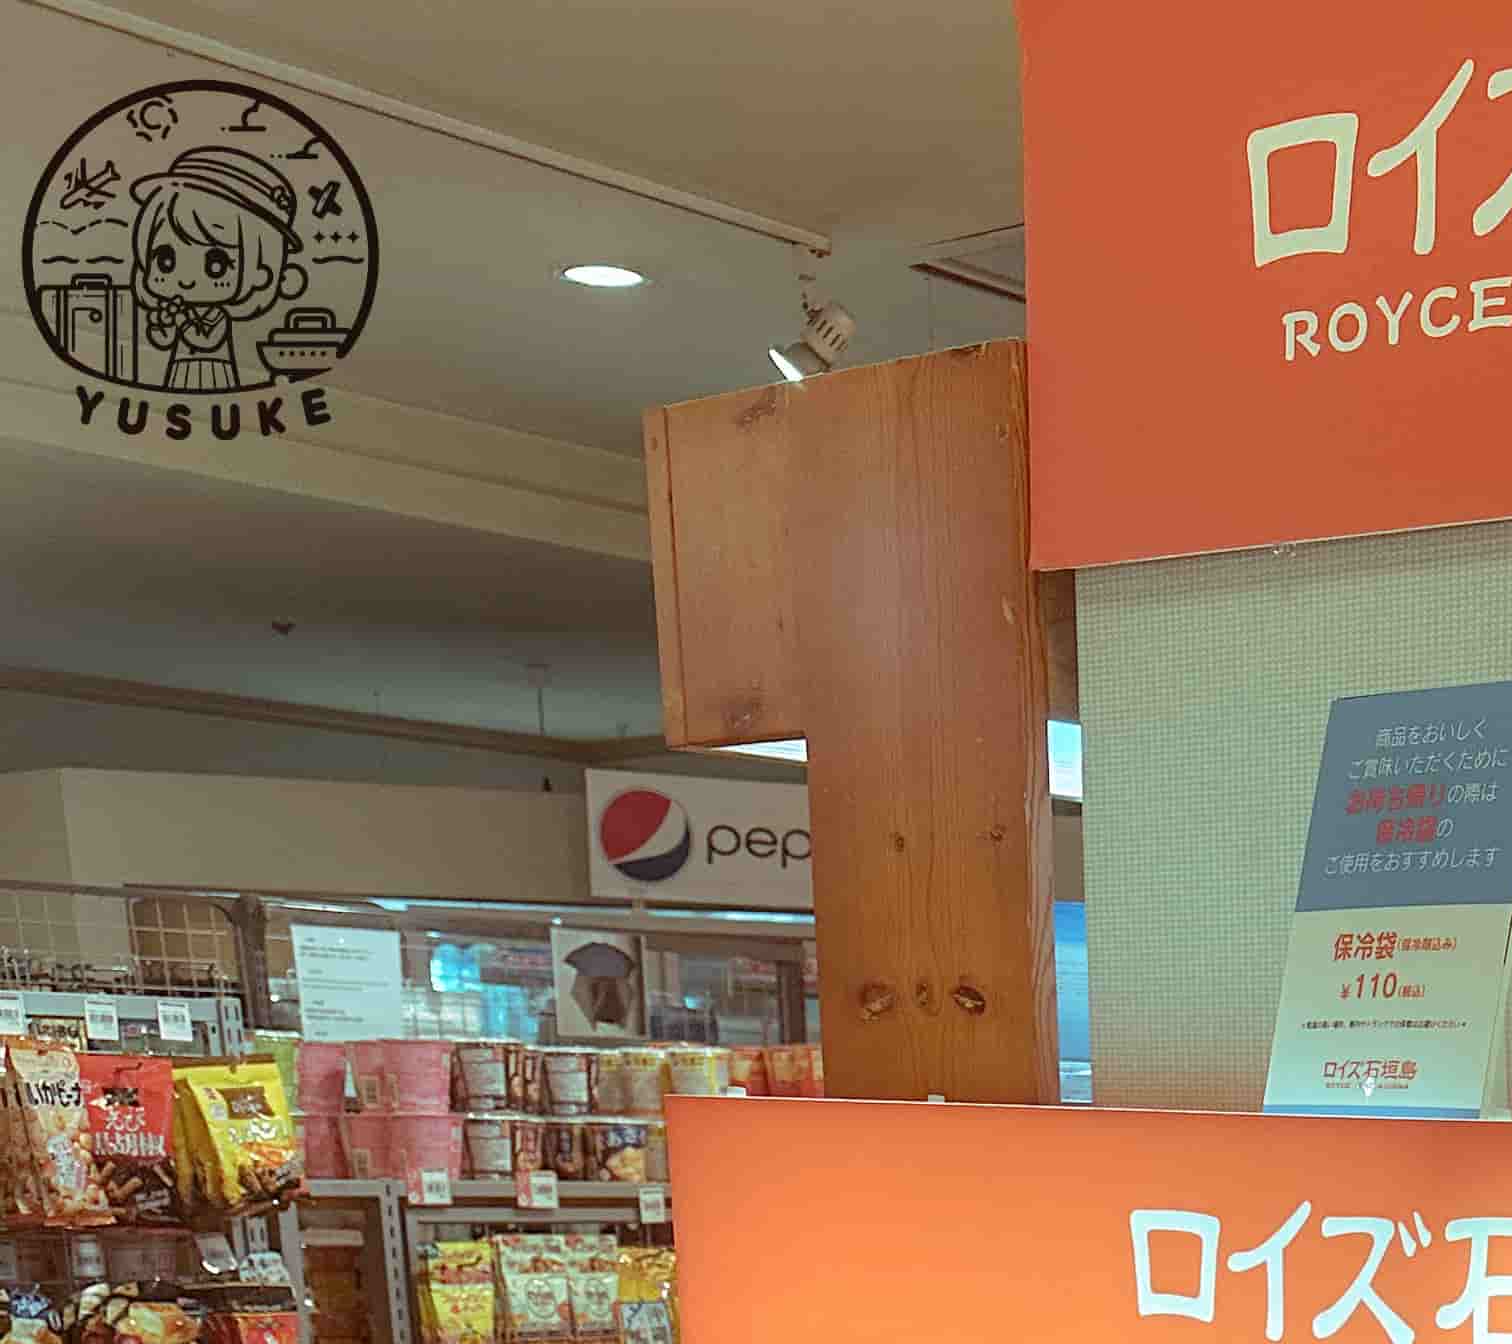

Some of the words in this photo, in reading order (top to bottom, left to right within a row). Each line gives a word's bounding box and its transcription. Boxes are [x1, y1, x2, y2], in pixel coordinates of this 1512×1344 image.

[1322, 1059, 1418, 1081] ロイズ石垣島
